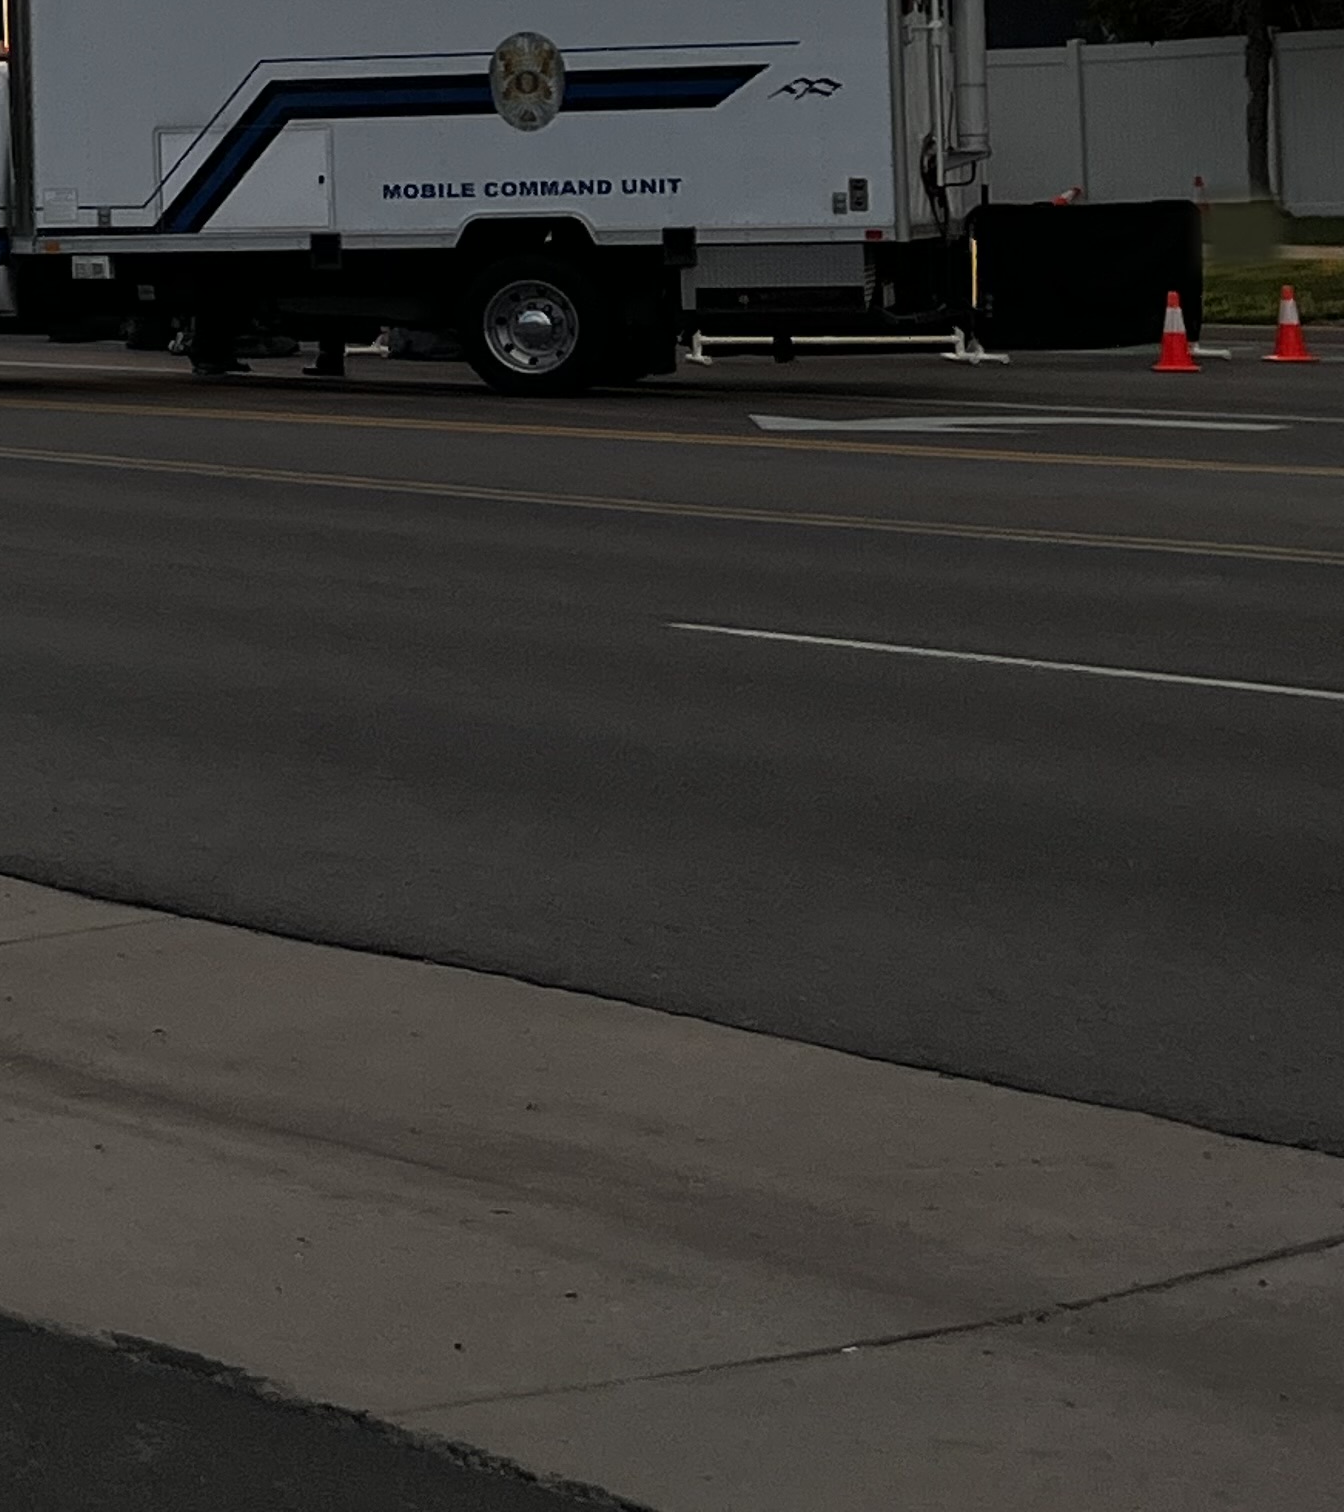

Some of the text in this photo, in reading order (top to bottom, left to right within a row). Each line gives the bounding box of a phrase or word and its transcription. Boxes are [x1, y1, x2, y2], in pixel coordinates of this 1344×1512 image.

[382, 177, 683, 199] MOBILE COMMAND UNIT
